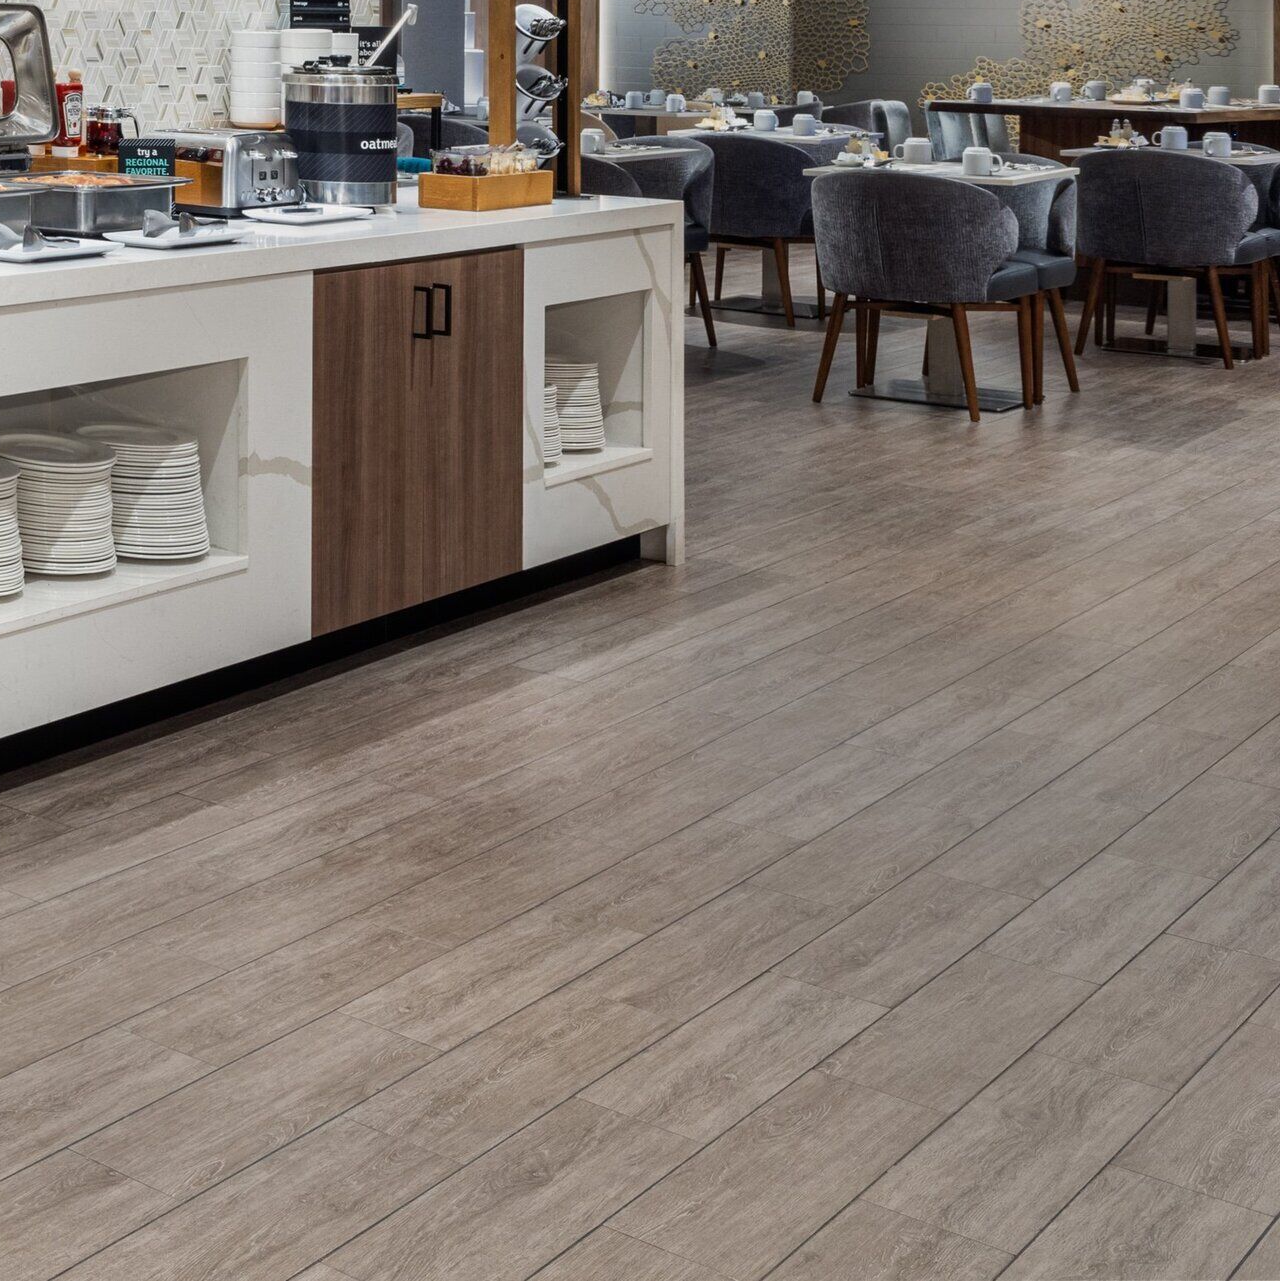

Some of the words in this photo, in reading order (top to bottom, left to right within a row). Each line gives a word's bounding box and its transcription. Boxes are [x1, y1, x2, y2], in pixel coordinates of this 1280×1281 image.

[137, 148, 151, 158] try
[126, 158, 169, 167] REGIONAL
[126, 167, 169, 176] FAVORITE.
